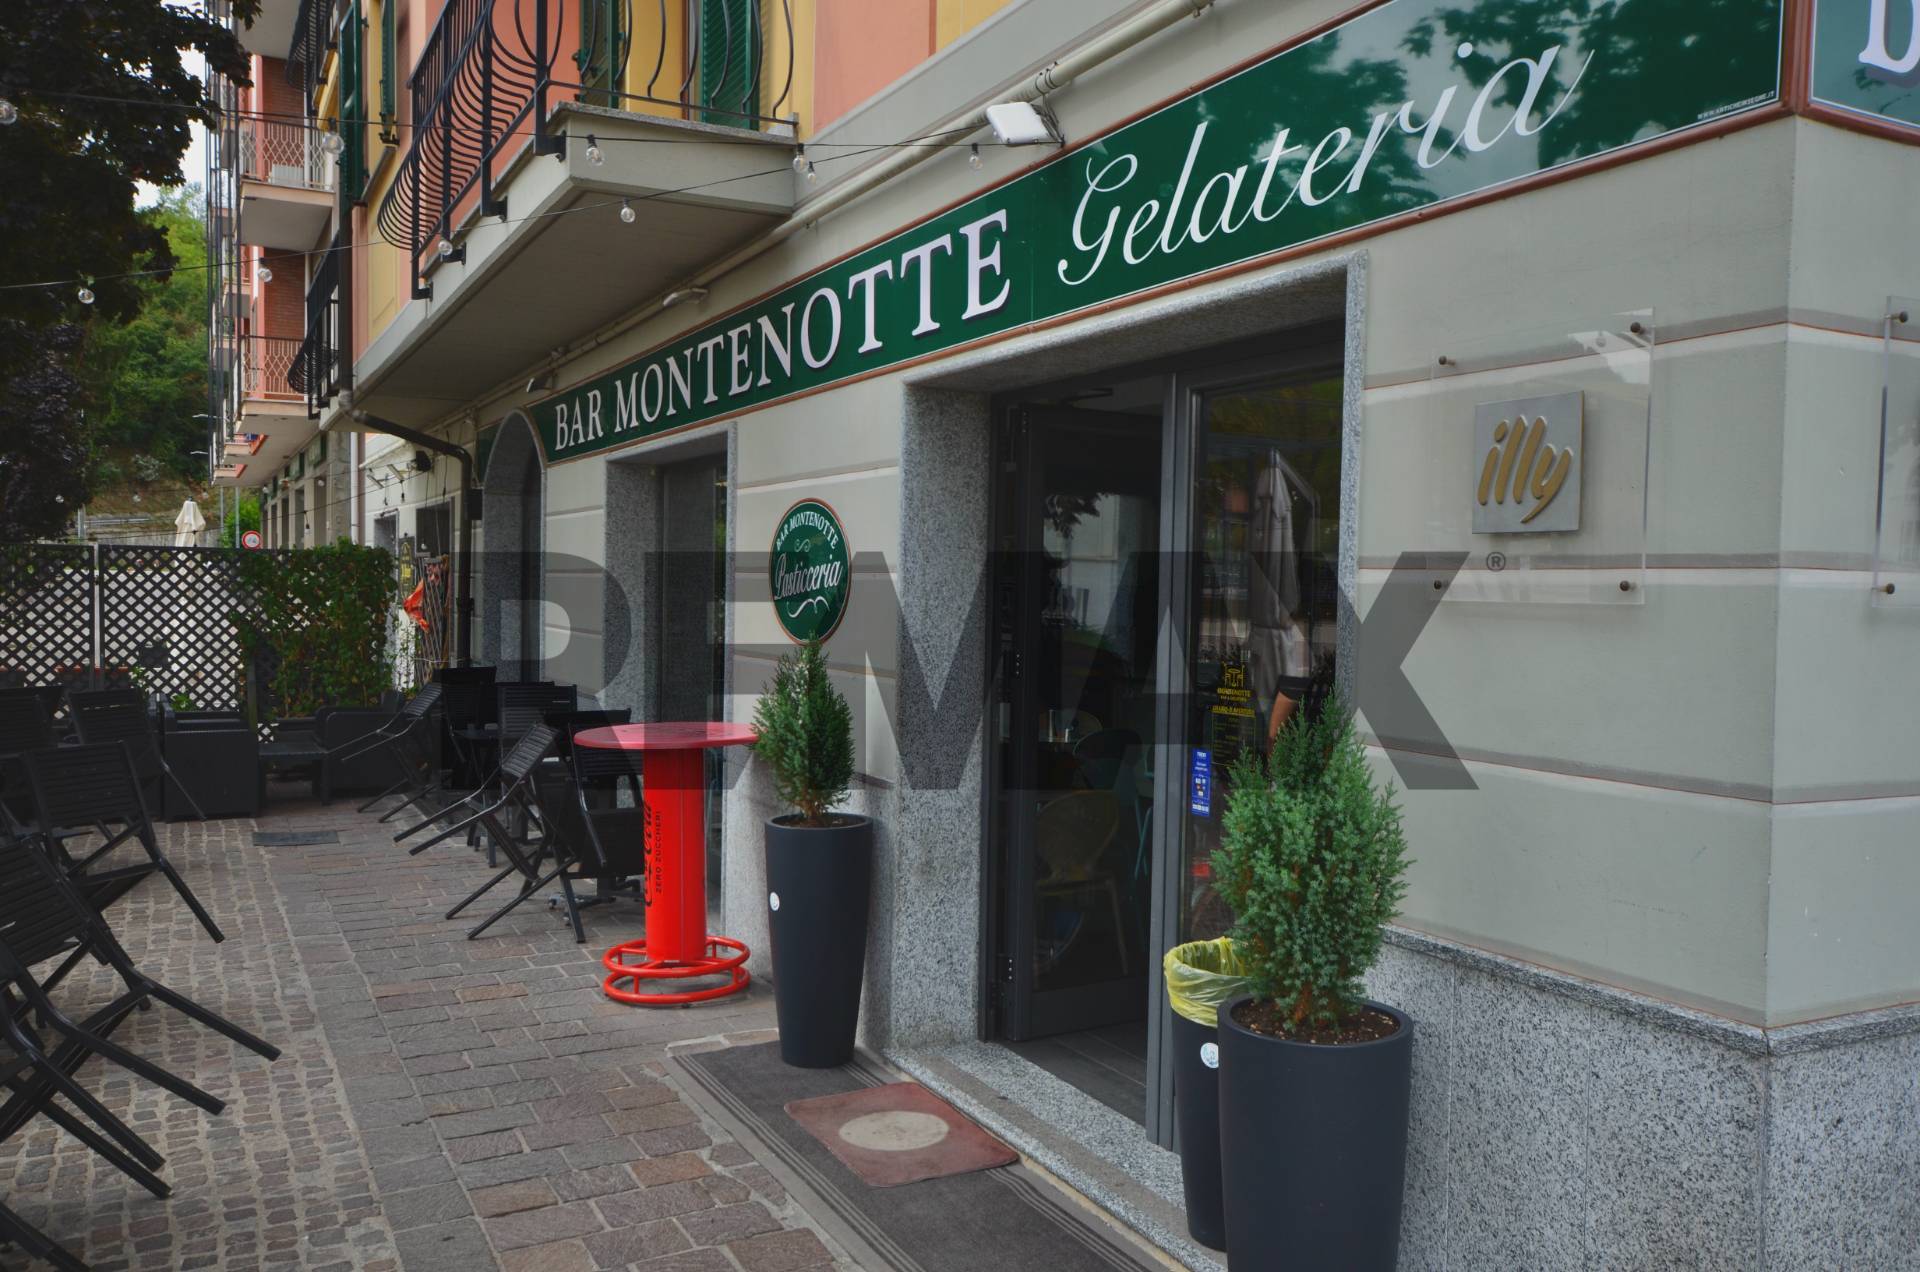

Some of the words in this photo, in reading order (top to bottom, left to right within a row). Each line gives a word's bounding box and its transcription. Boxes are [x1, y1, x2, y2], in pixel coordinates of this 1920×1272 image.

[554, 388, 604, 451] BAR
[613, 208, 1012, 433] MONTENOTTE
[1057, 42, 1595, 286] Gelateria
[1477, 415, 1574, 524] illy
[776, 524, 789, 551] BAR
[789, 511, 839, 550] MONTENOTTE
[774, 553, 843, 600] Pasticceria
[655, 810, 663, 863] ZUCCHERI
[655, 866, 663, 894] ZERO
